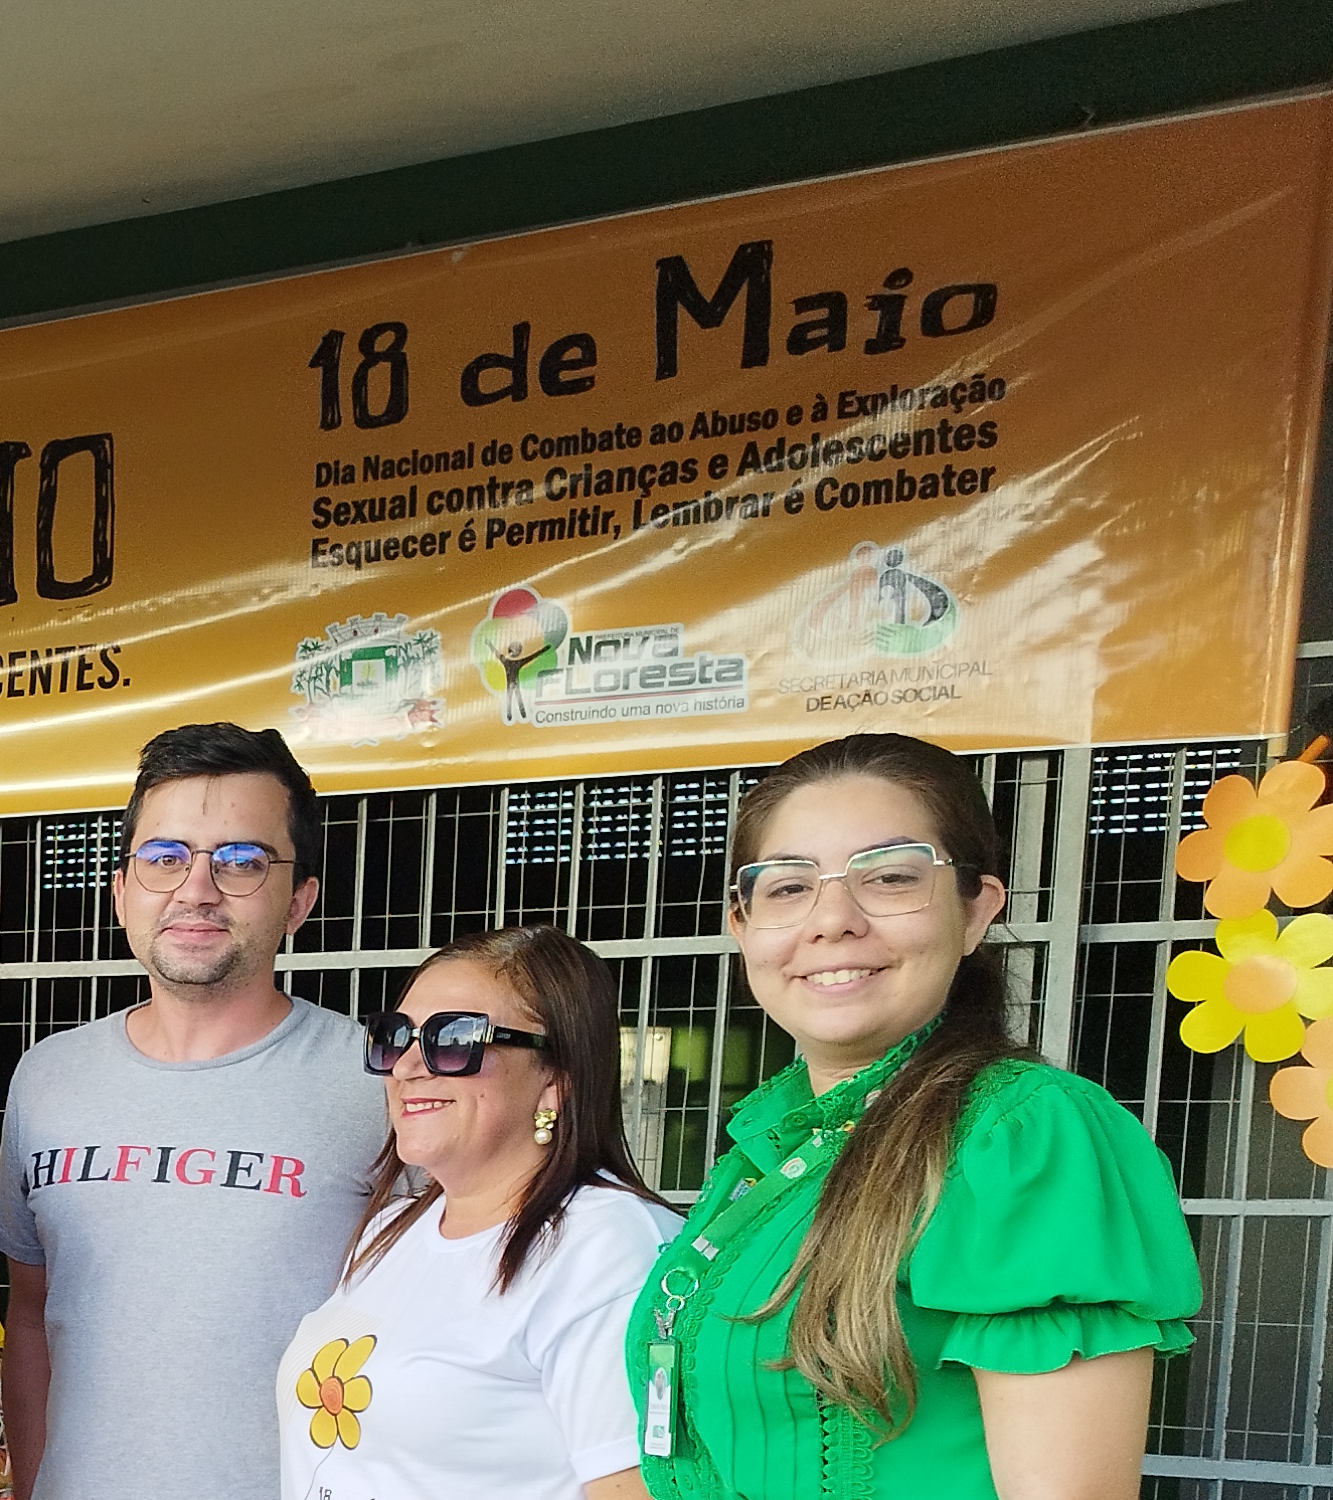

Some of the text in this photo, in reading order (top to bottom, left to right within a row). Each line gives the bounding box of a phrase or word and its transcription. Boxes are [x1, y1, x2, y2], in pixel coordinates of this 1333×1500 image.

[308, 238, 999, 431] 18 de Maio
[315, 373, 1007, 488] Dia Nacional de Combate ao Abuso e à Exploração
[311, 418, 998, 529] Sexual contra Crianças e Adolescentes
[311, 463, 997, 570] Esquecer é Permitir, Lembrar é Combater
[568, 635, 679, 665] Nova
[778, 660, 993, 695] SECRETARIA MUNICIPAL
[806, 685, 962, 713] DE AÇÃO SOCIAL
[535, 696, 745, 724] Construindo uma nova história
[31, 1145, 308, 1199] HILFIGER
